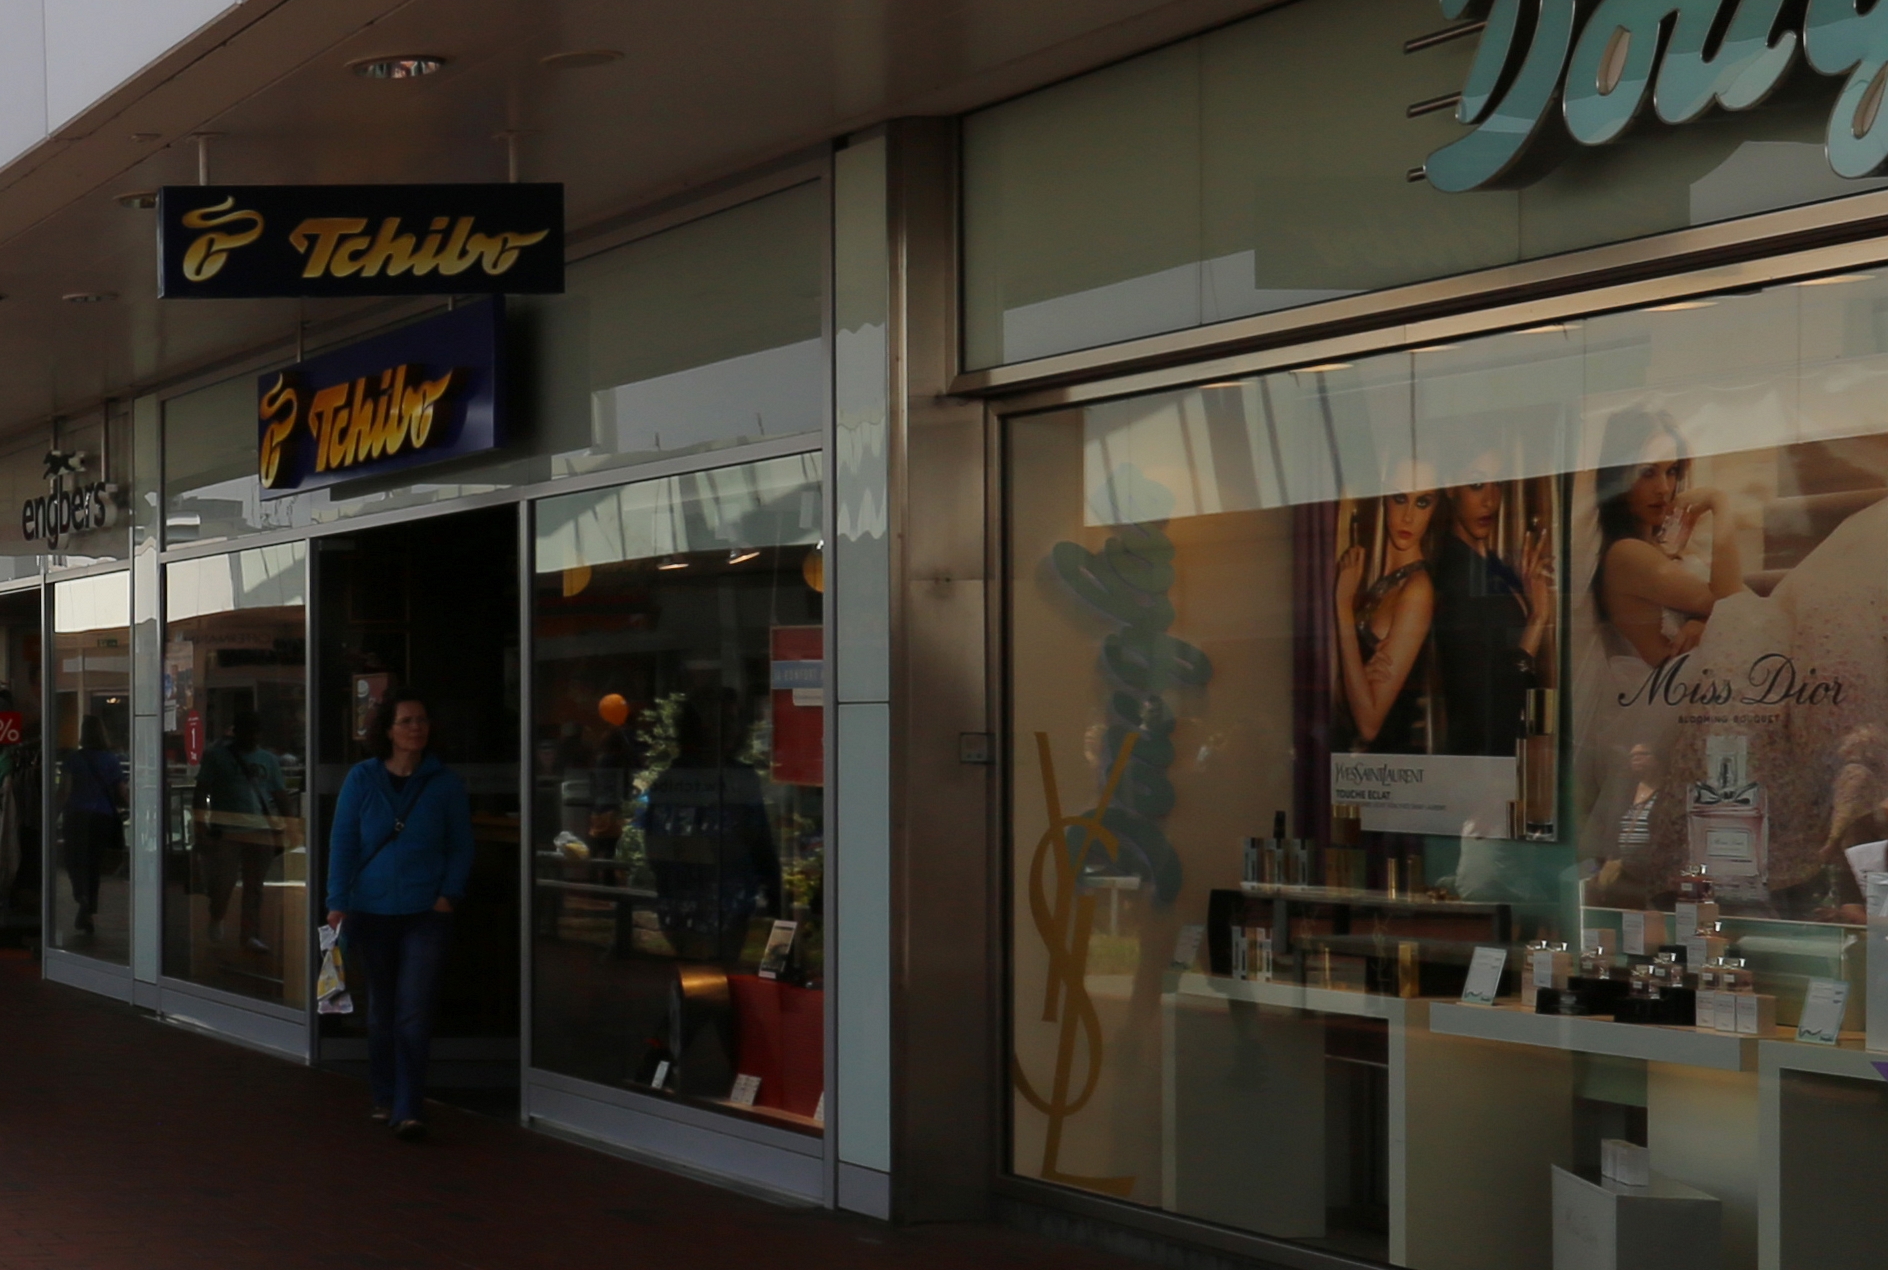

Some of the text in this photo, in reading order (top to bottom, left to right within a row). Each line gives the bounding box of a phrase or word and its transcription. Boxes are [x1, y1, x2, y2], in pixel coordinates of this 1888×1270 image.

[289, 216, 551, 279] Tchibo
[307, 364, 454, 473] Tchibo
[23, 481, 106, 550] engbers
[1618, 653, 1848, 707] Miss Dior
[1733, 714, 1780, 724] BOUQUET
[1336, 789, 1366, 799] TOUCHE
